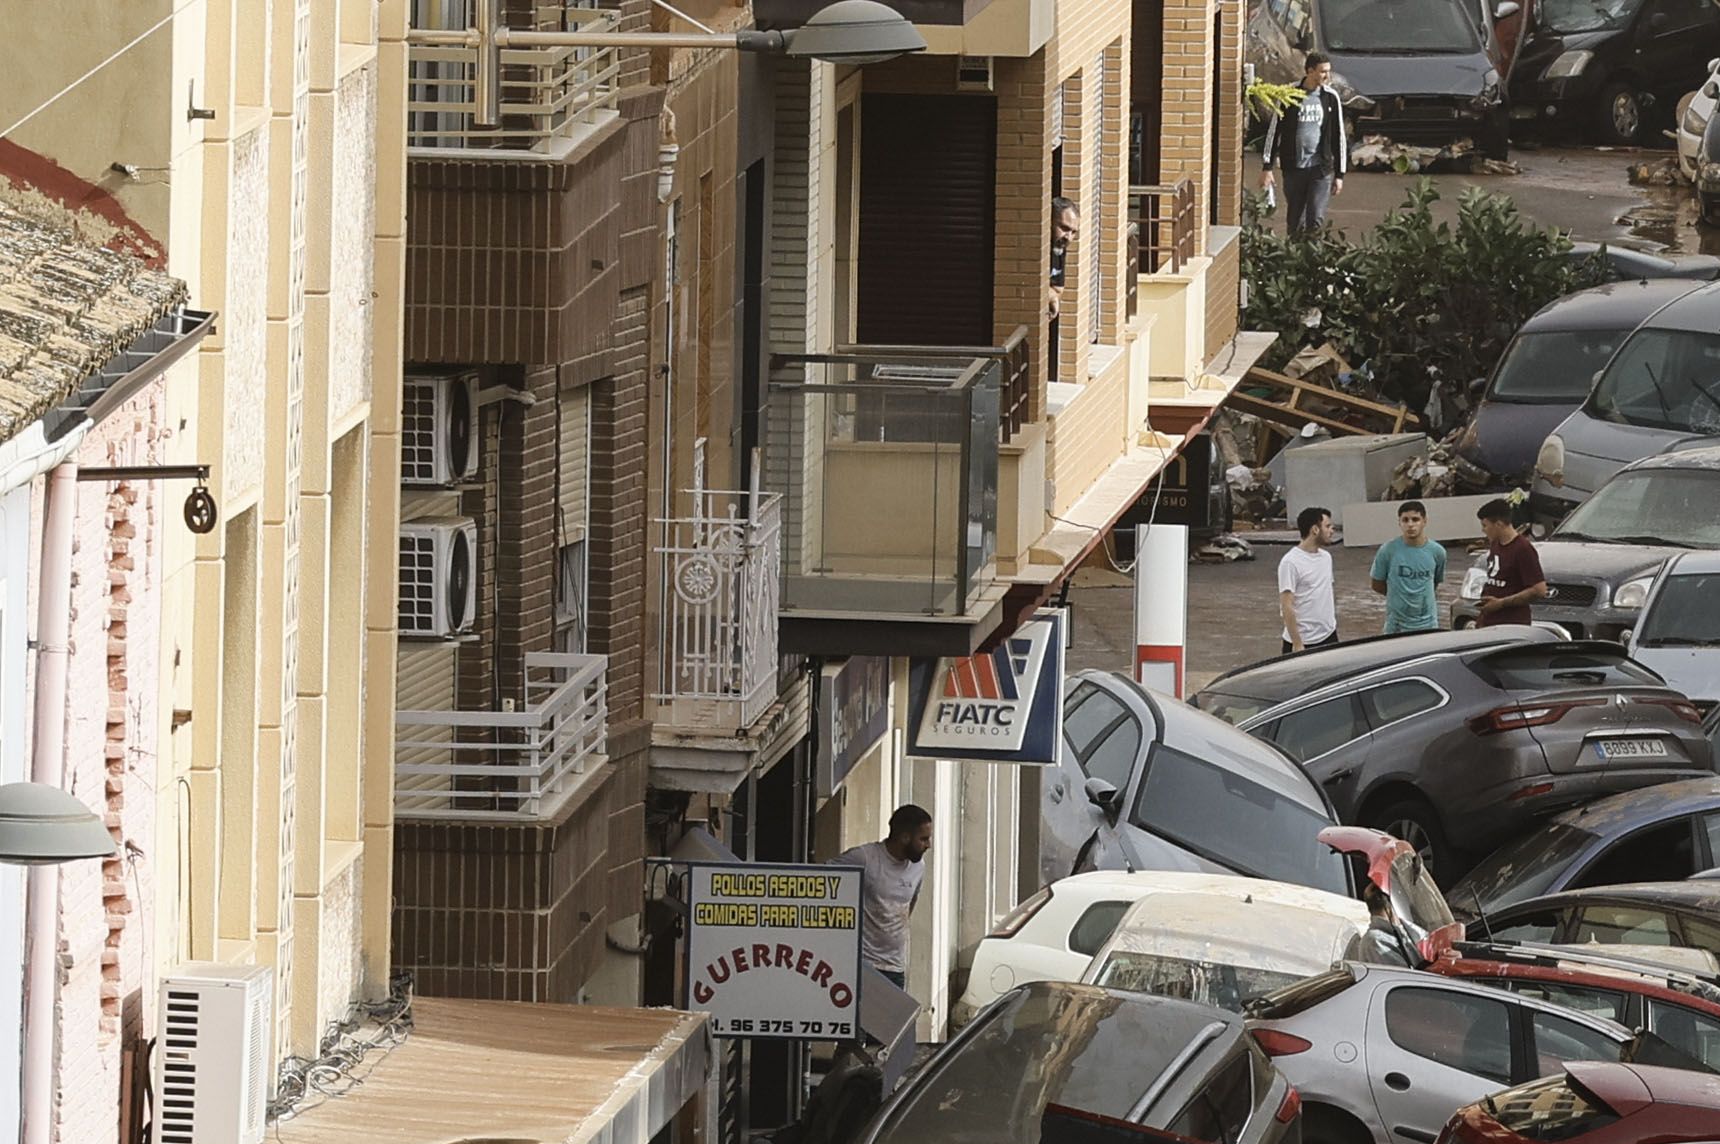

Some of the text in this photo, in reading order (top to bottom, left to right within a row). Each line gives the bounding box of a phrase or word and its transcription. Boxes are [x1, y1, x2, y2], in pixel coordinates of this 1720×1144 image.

[937, 703, 1015, 726] FIATC
[934, 725, 1011, 736] SEGUROS
[711, 873, 841, 899] POLLOS ASADOS Y
[695, 902, 856, 929] COMIDAS PARA LLEVAR
[693, 943, 853, 1008] GUERRERO
[731, 1019, 753, 1032] 96
[760, 1020, 793, 1033] 375
[800, 1021, 822, 1034] 70
[828, 1022, 851, 1034] 76
